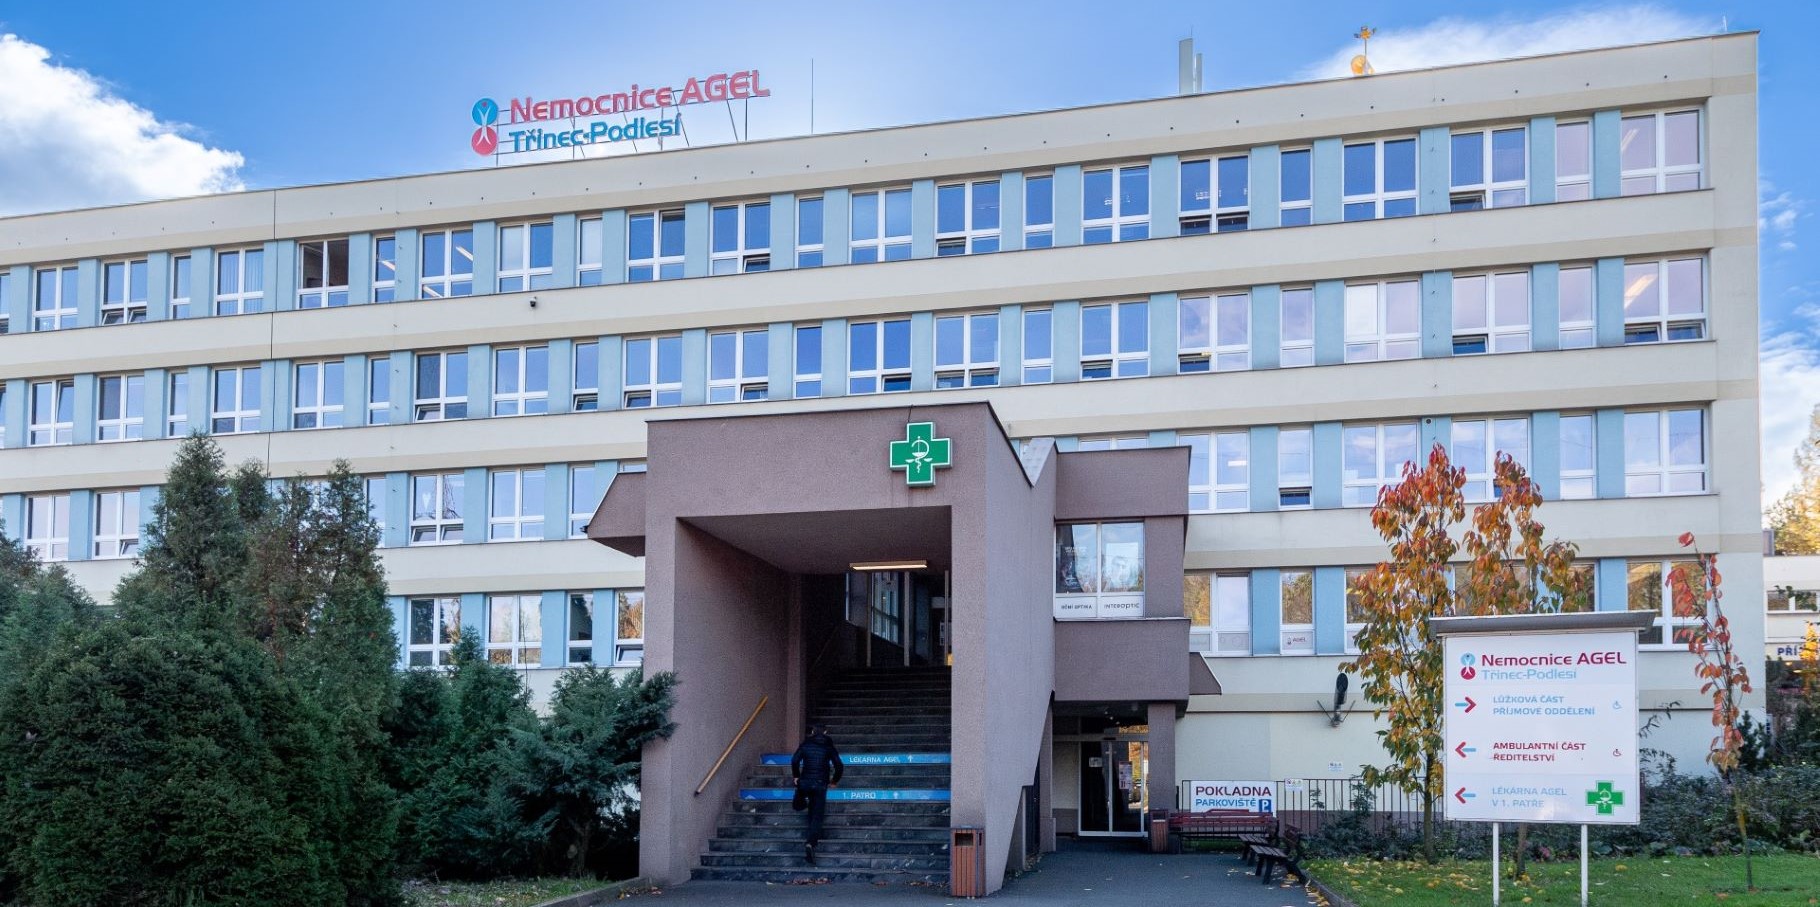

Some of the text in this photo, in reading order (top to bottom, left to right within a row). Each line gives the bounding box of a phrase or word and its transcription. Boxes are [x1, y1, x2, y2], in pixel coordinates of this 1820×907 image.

[510, 69, 770, 124] Nemocnice AGEL
[509, 112, 682, 153] Třinec-Podlesí
[1777, 645, 1798, 656] PŘÍ
[1482, 652, 1627, 667] Nemocnice AGEL
[1482, 668, 1577, 680] Třinec-Podlesí
[1493, 695, 1564, 704] LŮŽKOVÁ ČÁST
[1493, 706, 1595, 716] PŘÍJMOVÉ ODDĚLENÍ
[1493, 741, 1586, 751] AMBULANTNÍ ČÁST
[1493, 752, 1555, 762] ŘEDITELSTVÍ
[1196, 786, 1272, 796] POKLADNA
[1492, 786, 1567, 796] LÉKÁRNA AGEL
[1195, 797, 1256, 807] PARKOVIŠTĚ
[1492, 799, 1499, 808] V
[1502, 799, 1510, 808] 1.
